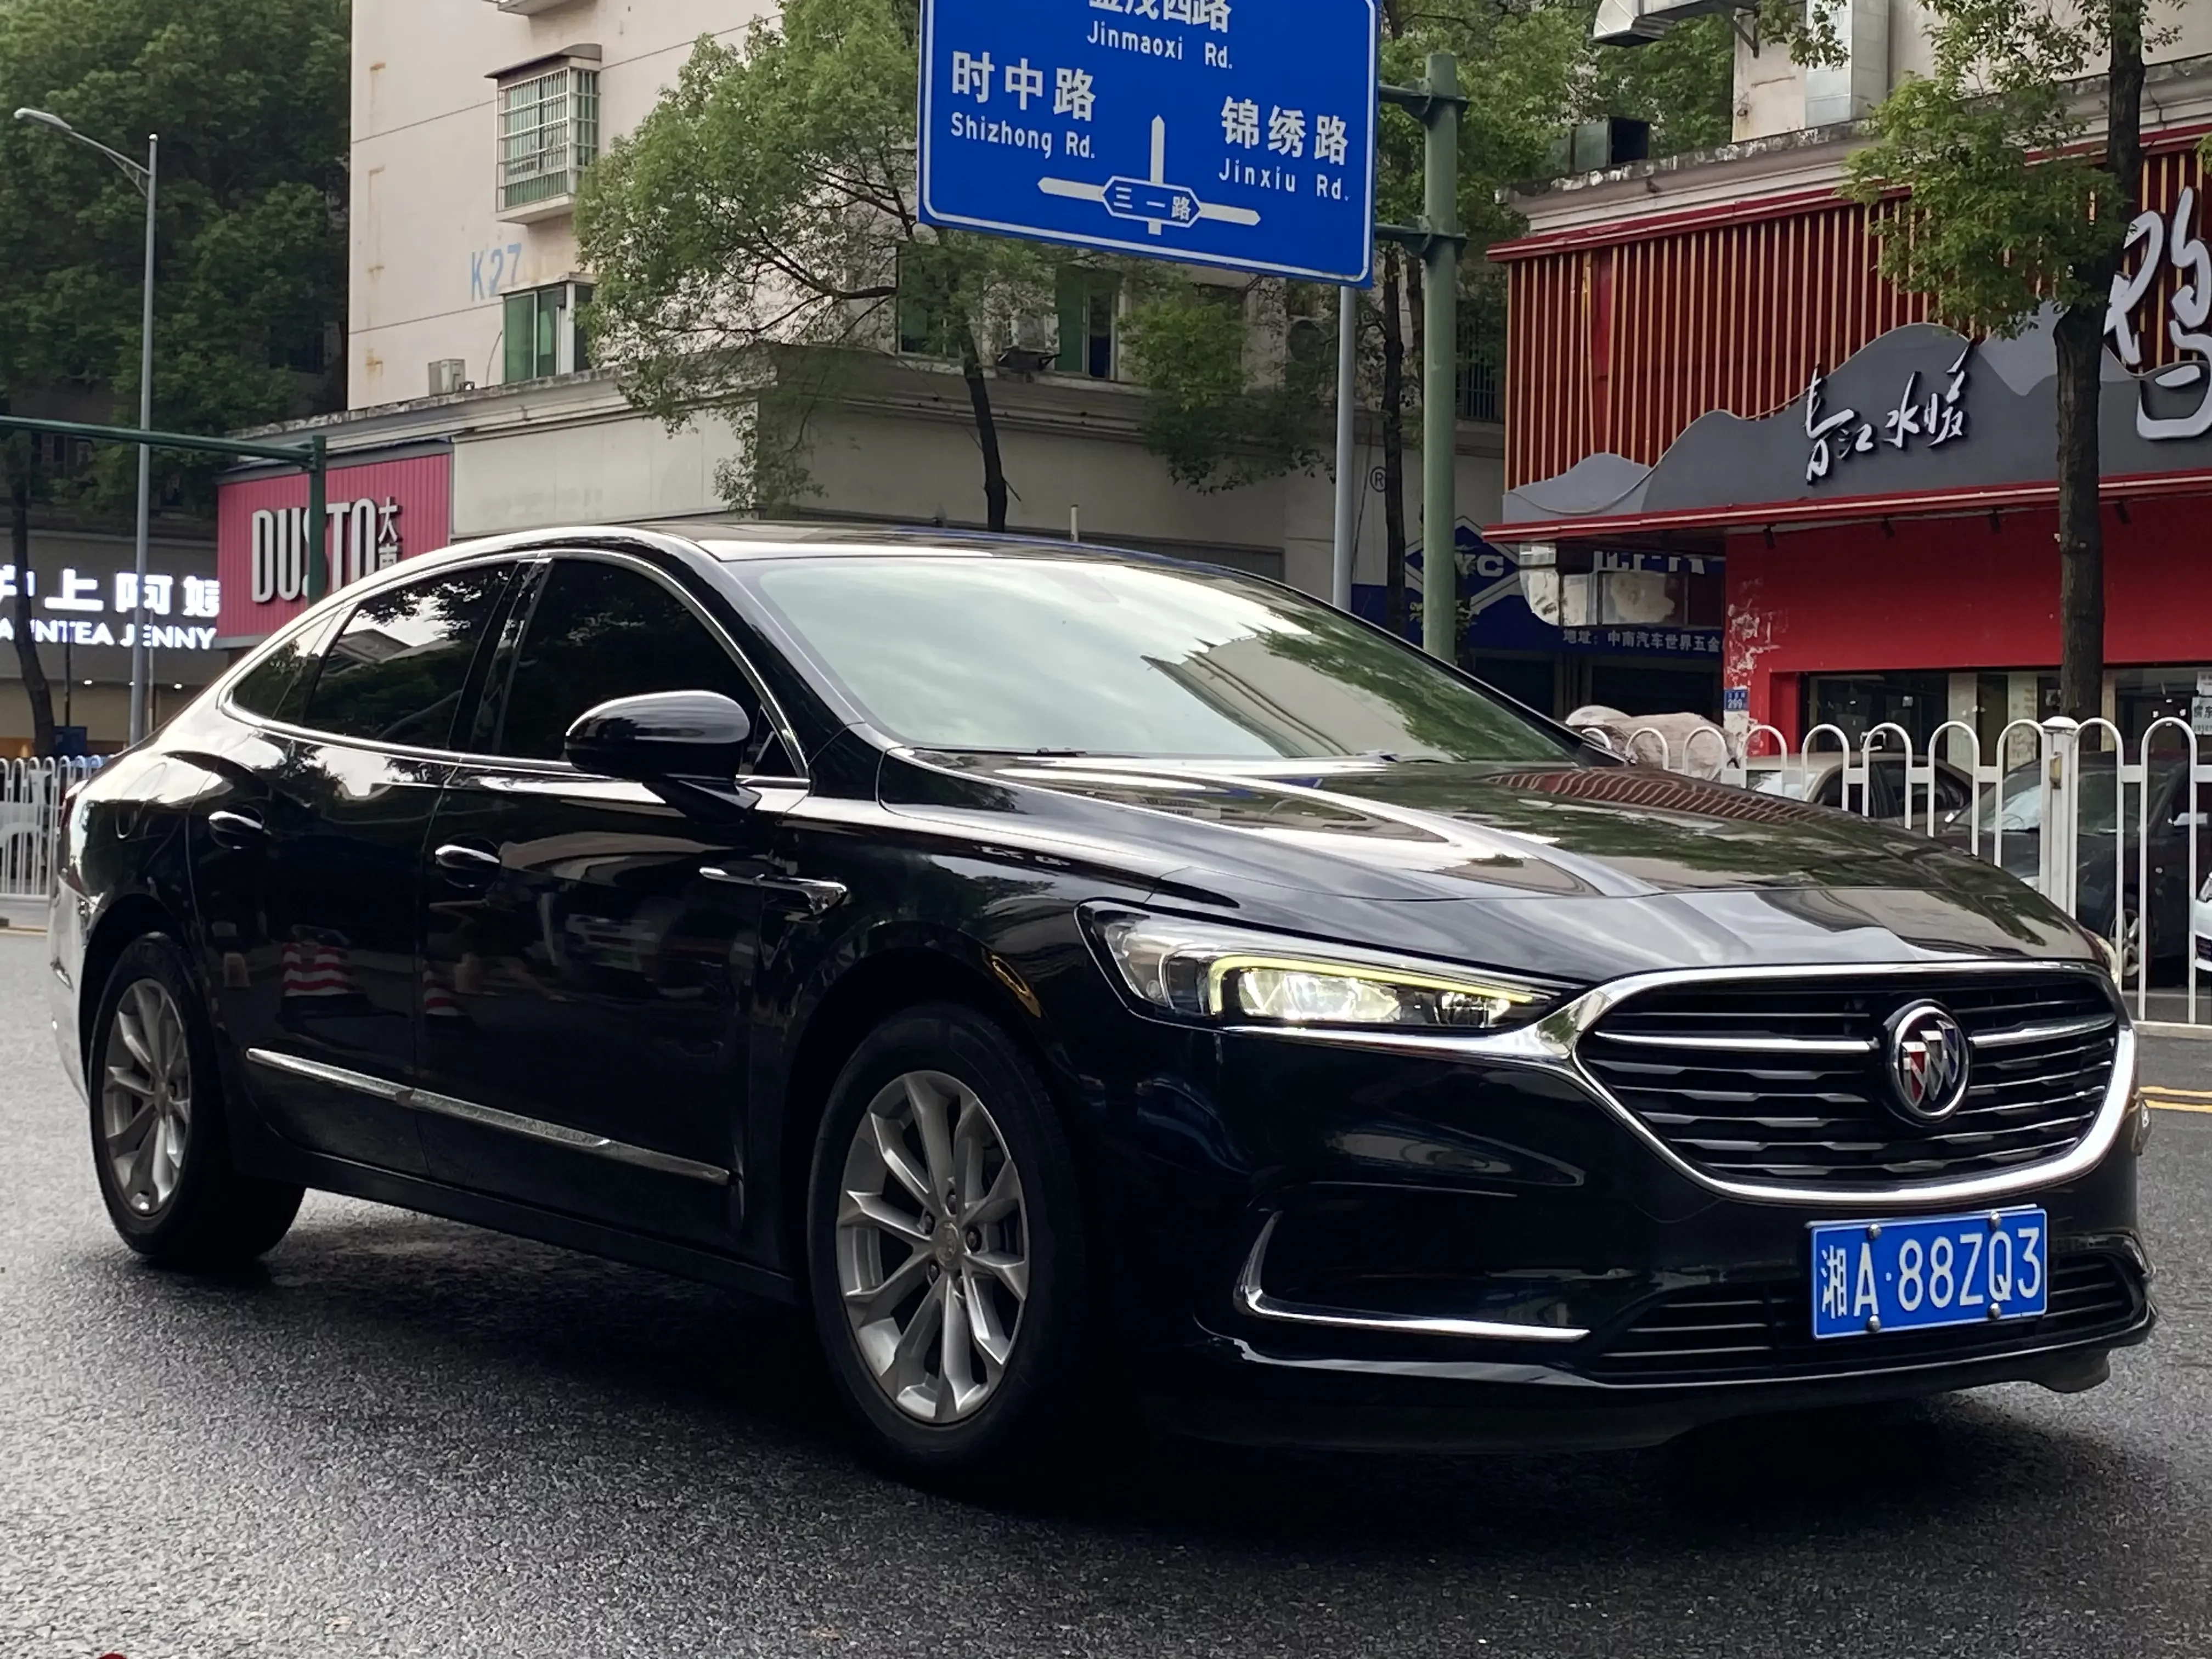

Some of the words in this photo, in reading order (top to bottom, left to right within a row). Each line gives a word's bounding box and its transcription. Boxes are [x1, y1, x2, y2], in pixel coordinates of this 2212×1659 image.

[1089, 0, 1232, 33] 西路
[1087, 20, 1182, 60] Jinmaoxi
[1205, 42, 1233, 69] Rd.
[952, 50, 1097, 122] 时中路
[951, 112, 1053, 159] Shizhong
[1065, 131, 1096, 159] Rd.
[1221, 96, 1348, 165] 锦绣路
[1114, 187, 1191, 221] 三一路
[1218, 159, 1296, 193] Jinxiu
[1316, 174, 1351, 202] Rd.
[471, 243, 522, 302] K27
[252, 498, 376, 603] DUTO
[1421, 552, 1504, 577] YC
[0, 617, 115, 645] ANTEA
[1821, 1227, 2041, 1319] 湘A·88ZQ3
